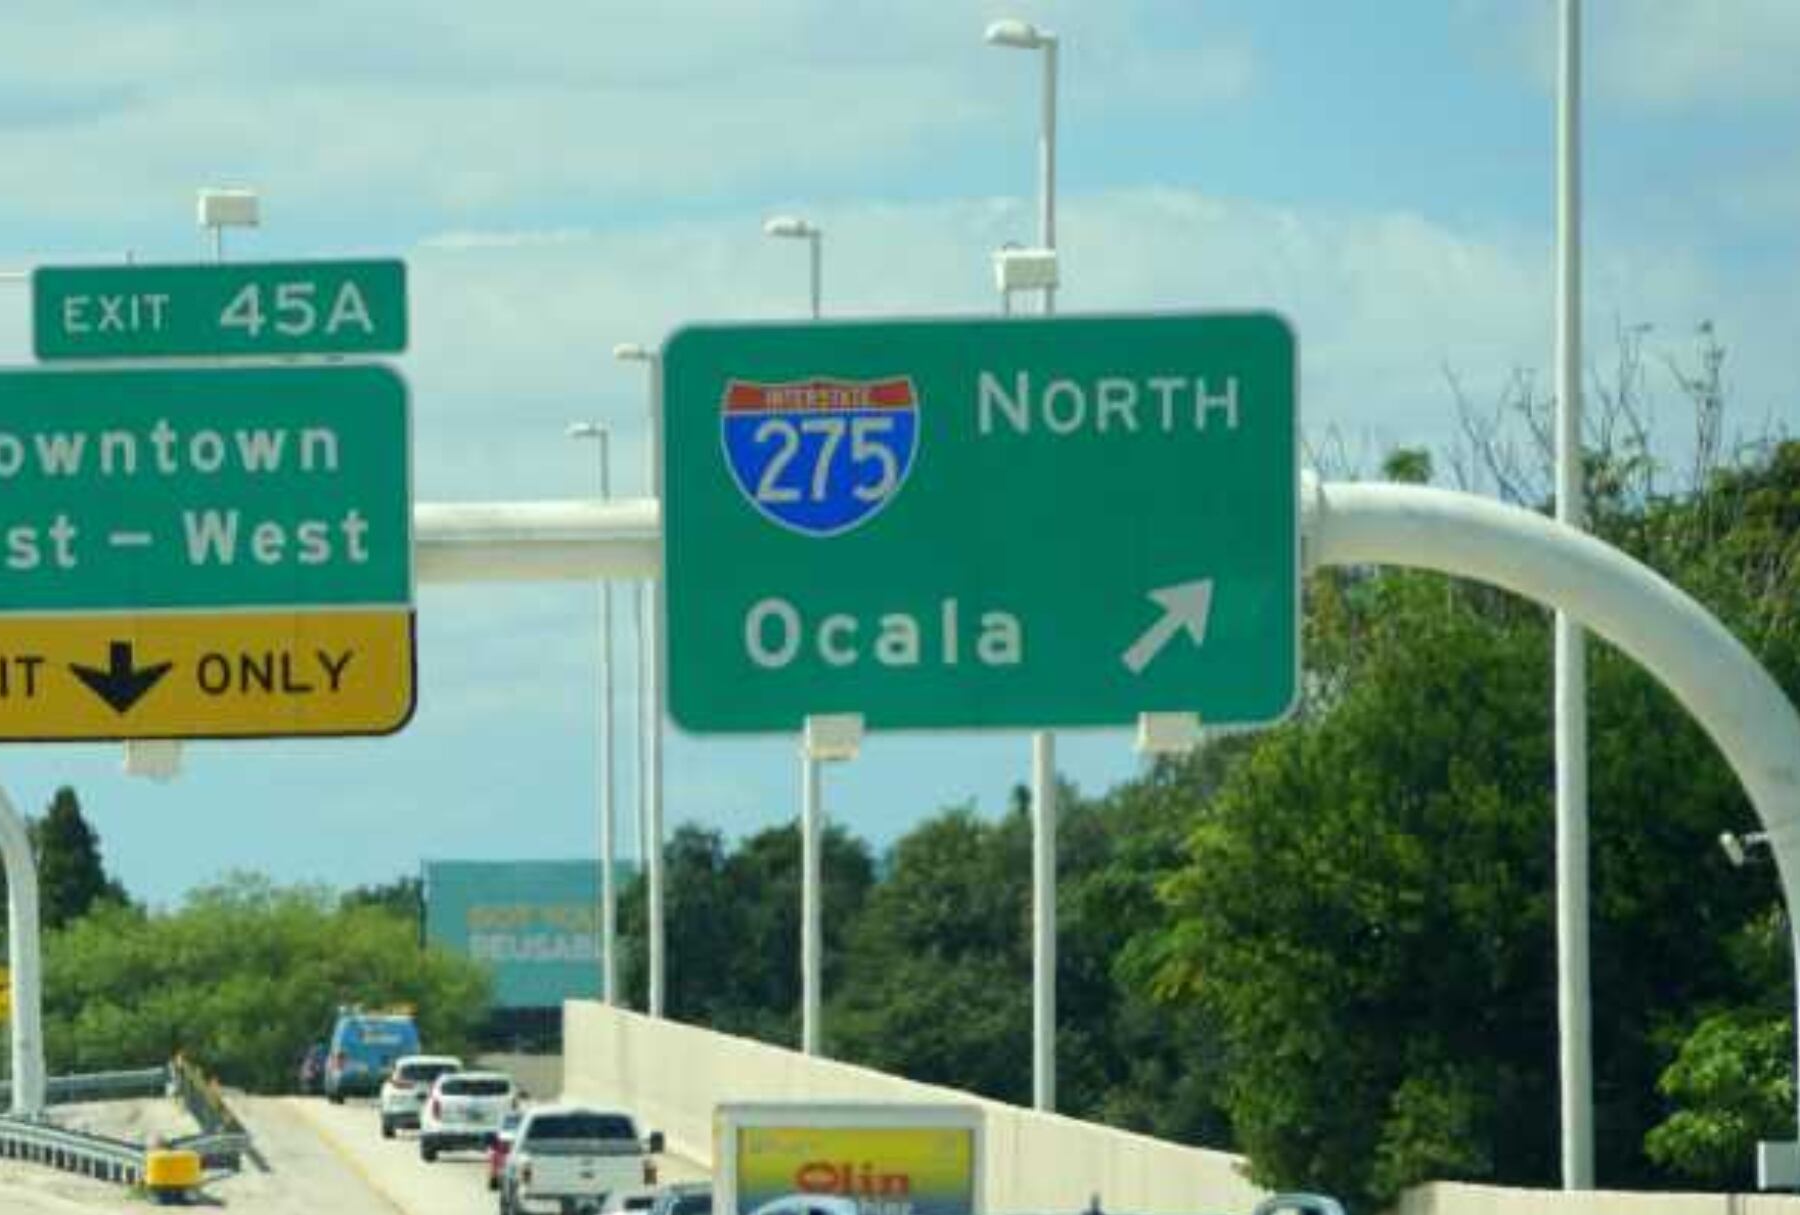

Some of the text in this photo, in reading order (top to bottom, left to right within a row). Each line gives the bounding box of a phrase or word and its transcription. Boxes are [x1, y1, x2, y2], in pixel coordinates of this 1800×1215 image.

[63, 281, 374, 336] EXIT 45A
[977, 371, 1240, 435] NORTH
[754, 417, 899, 503] 275
[183, 509, 370, 565] West
[744, 597, 1022, 668] Ocala
[196, 649, 355, 695] ONLY
